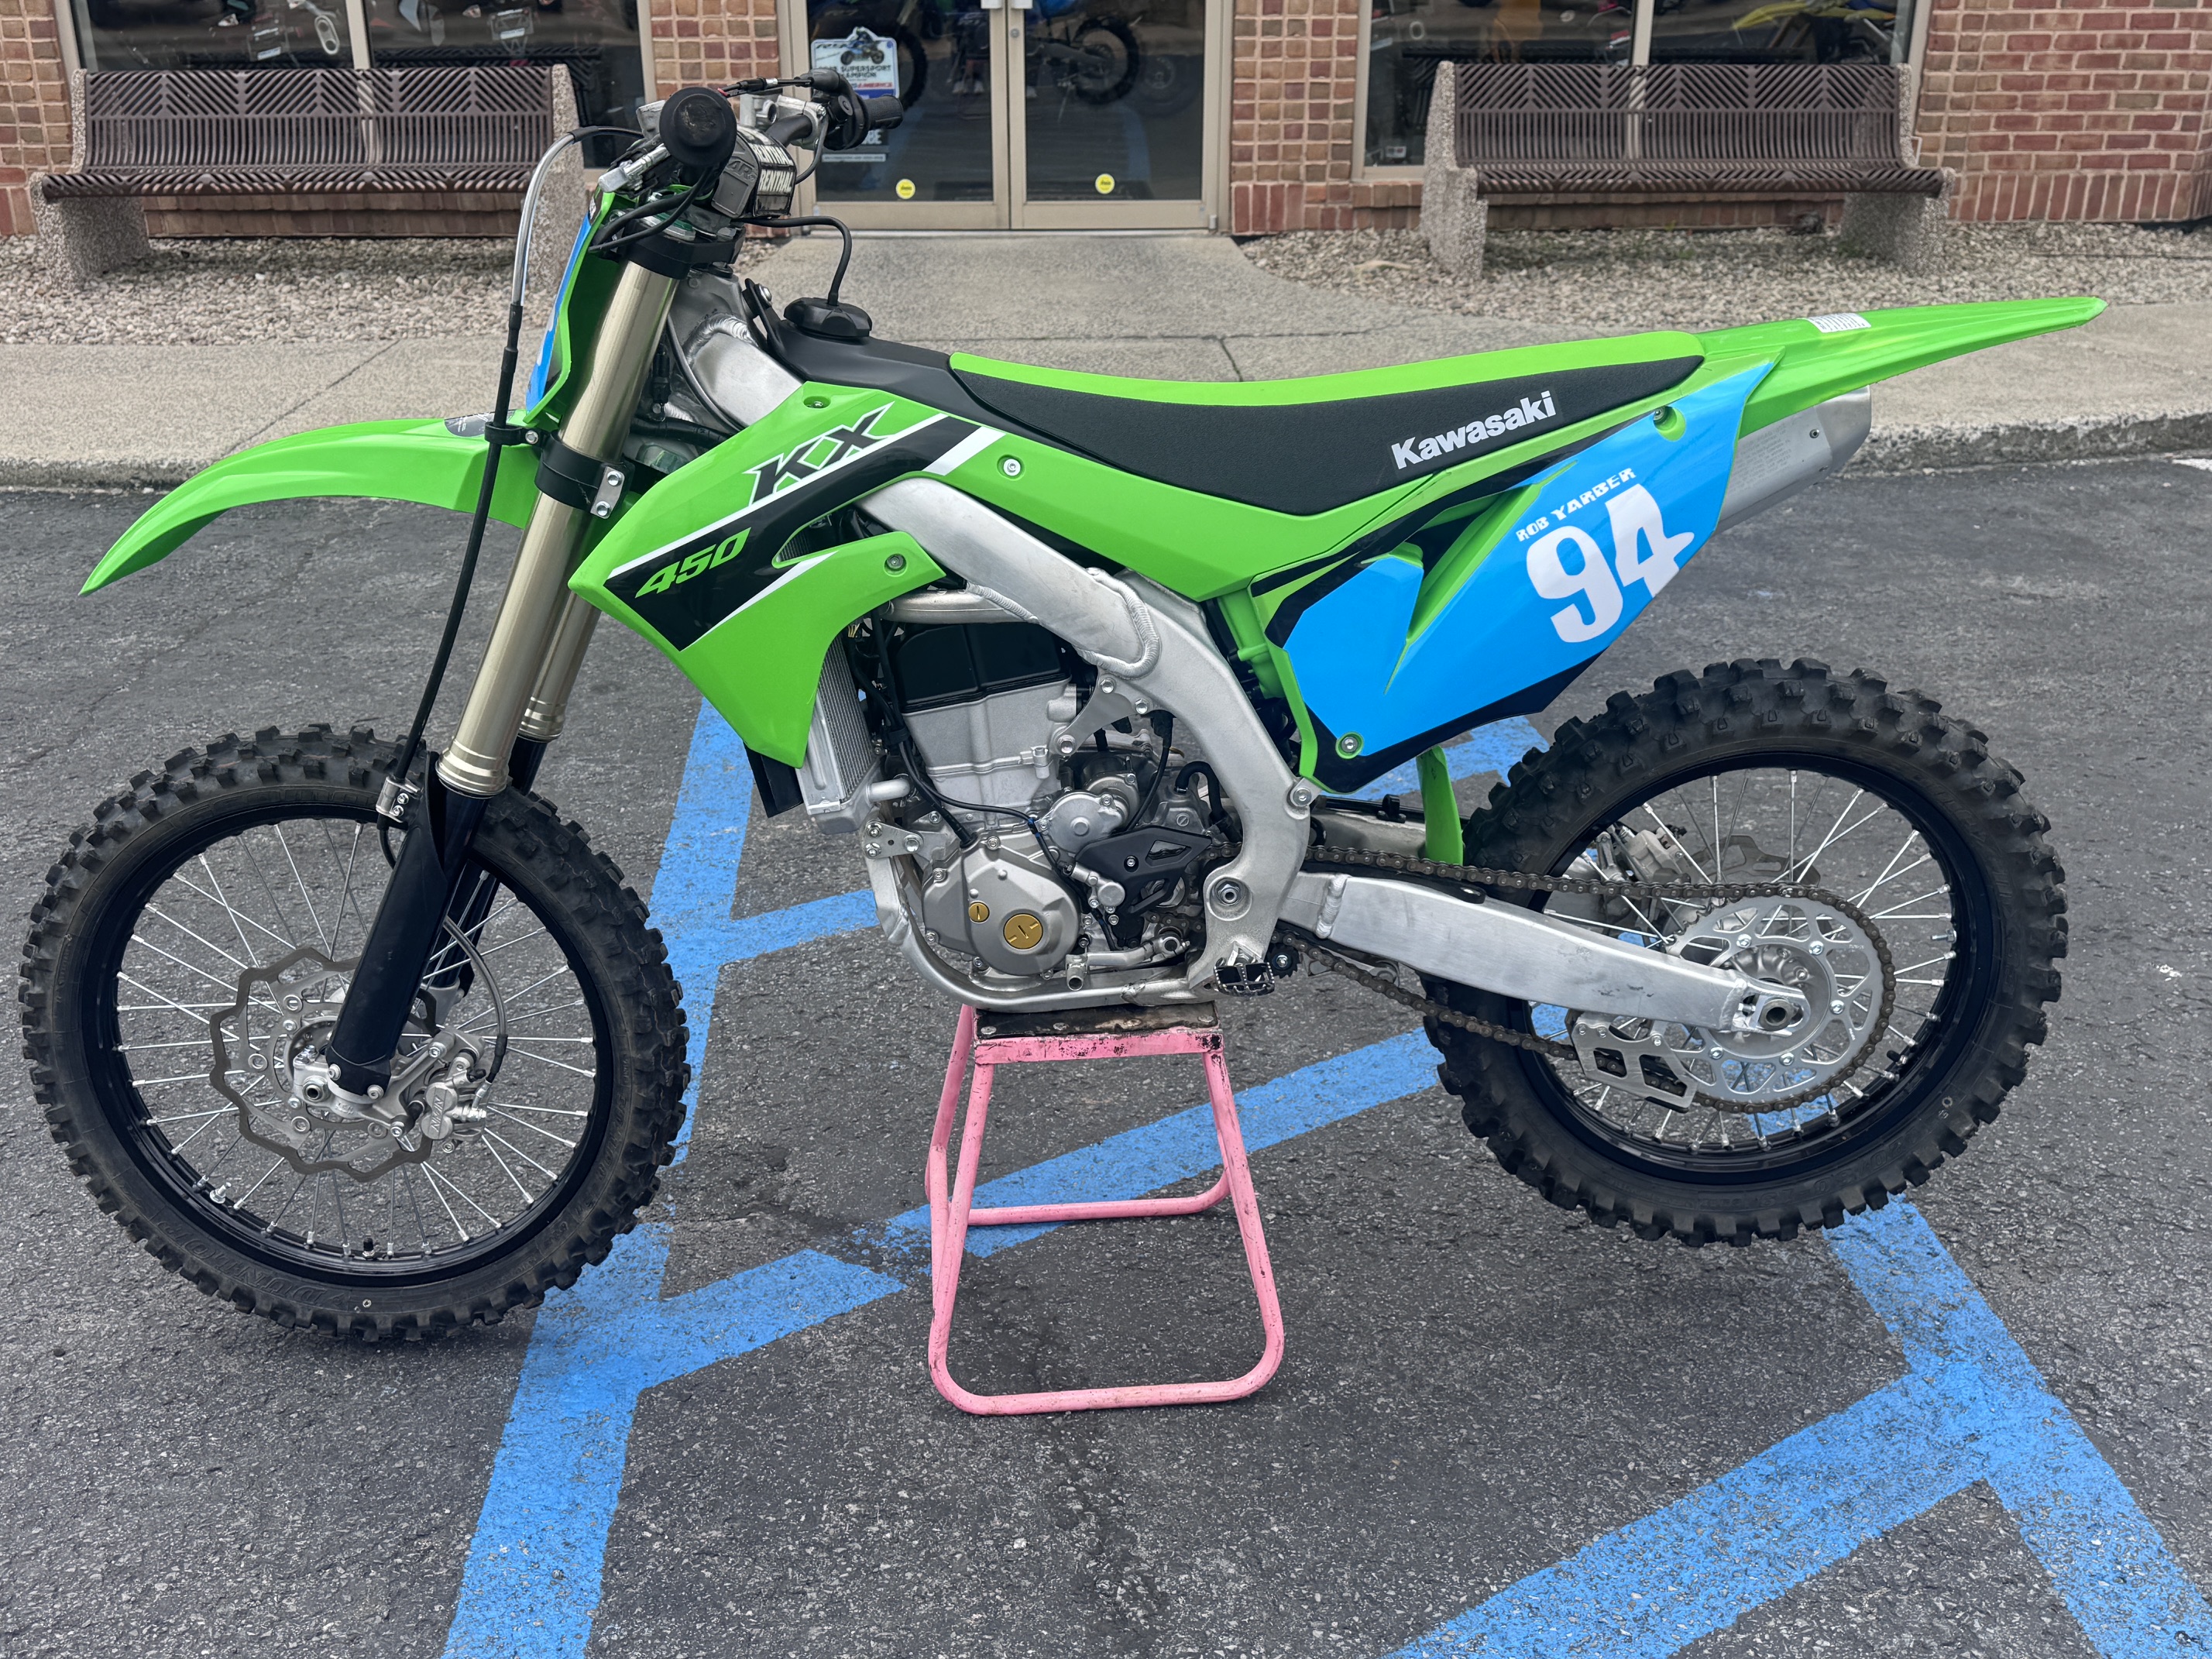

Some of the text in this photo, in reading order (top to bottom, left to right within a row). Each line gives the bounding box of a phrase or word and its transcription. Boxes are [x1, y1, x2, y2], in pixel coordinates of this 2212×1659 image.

[758, 169, 794, 193] RENTHAL
[741, 400, 901, 507] KX
[1391, 390, 1557, 469] Kawasaki
[1516, 467, 1637, 542] ROB YARBER
[634, 527, 752, 599] 450
[1526, 483, 1695, 643] 94
[156, 1220, 327, 1306] DUNLOP
